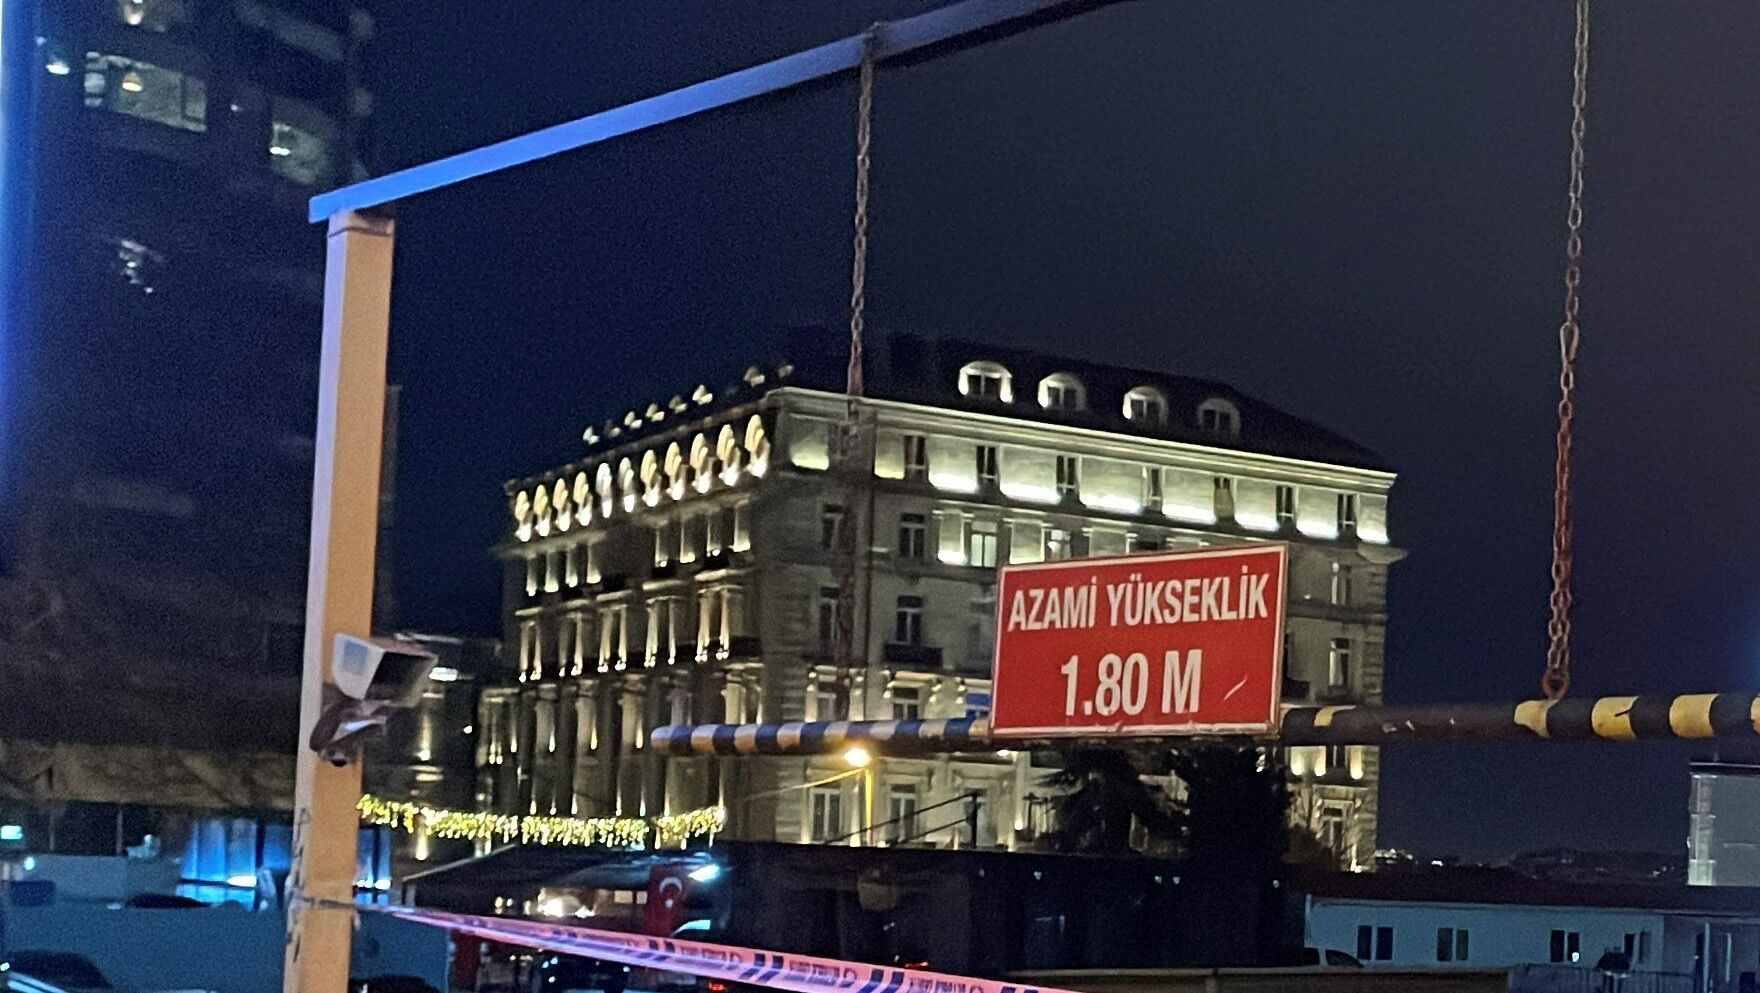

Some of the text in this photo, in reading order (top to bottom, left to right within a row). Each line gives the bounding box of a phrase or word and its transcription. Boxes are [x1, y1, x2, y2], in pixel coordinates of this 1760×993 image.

[1007, 565, 1270, 631] AZAMİ YÜKSEKLİK
[1060, 649, 1203, 716] 1.80 M
